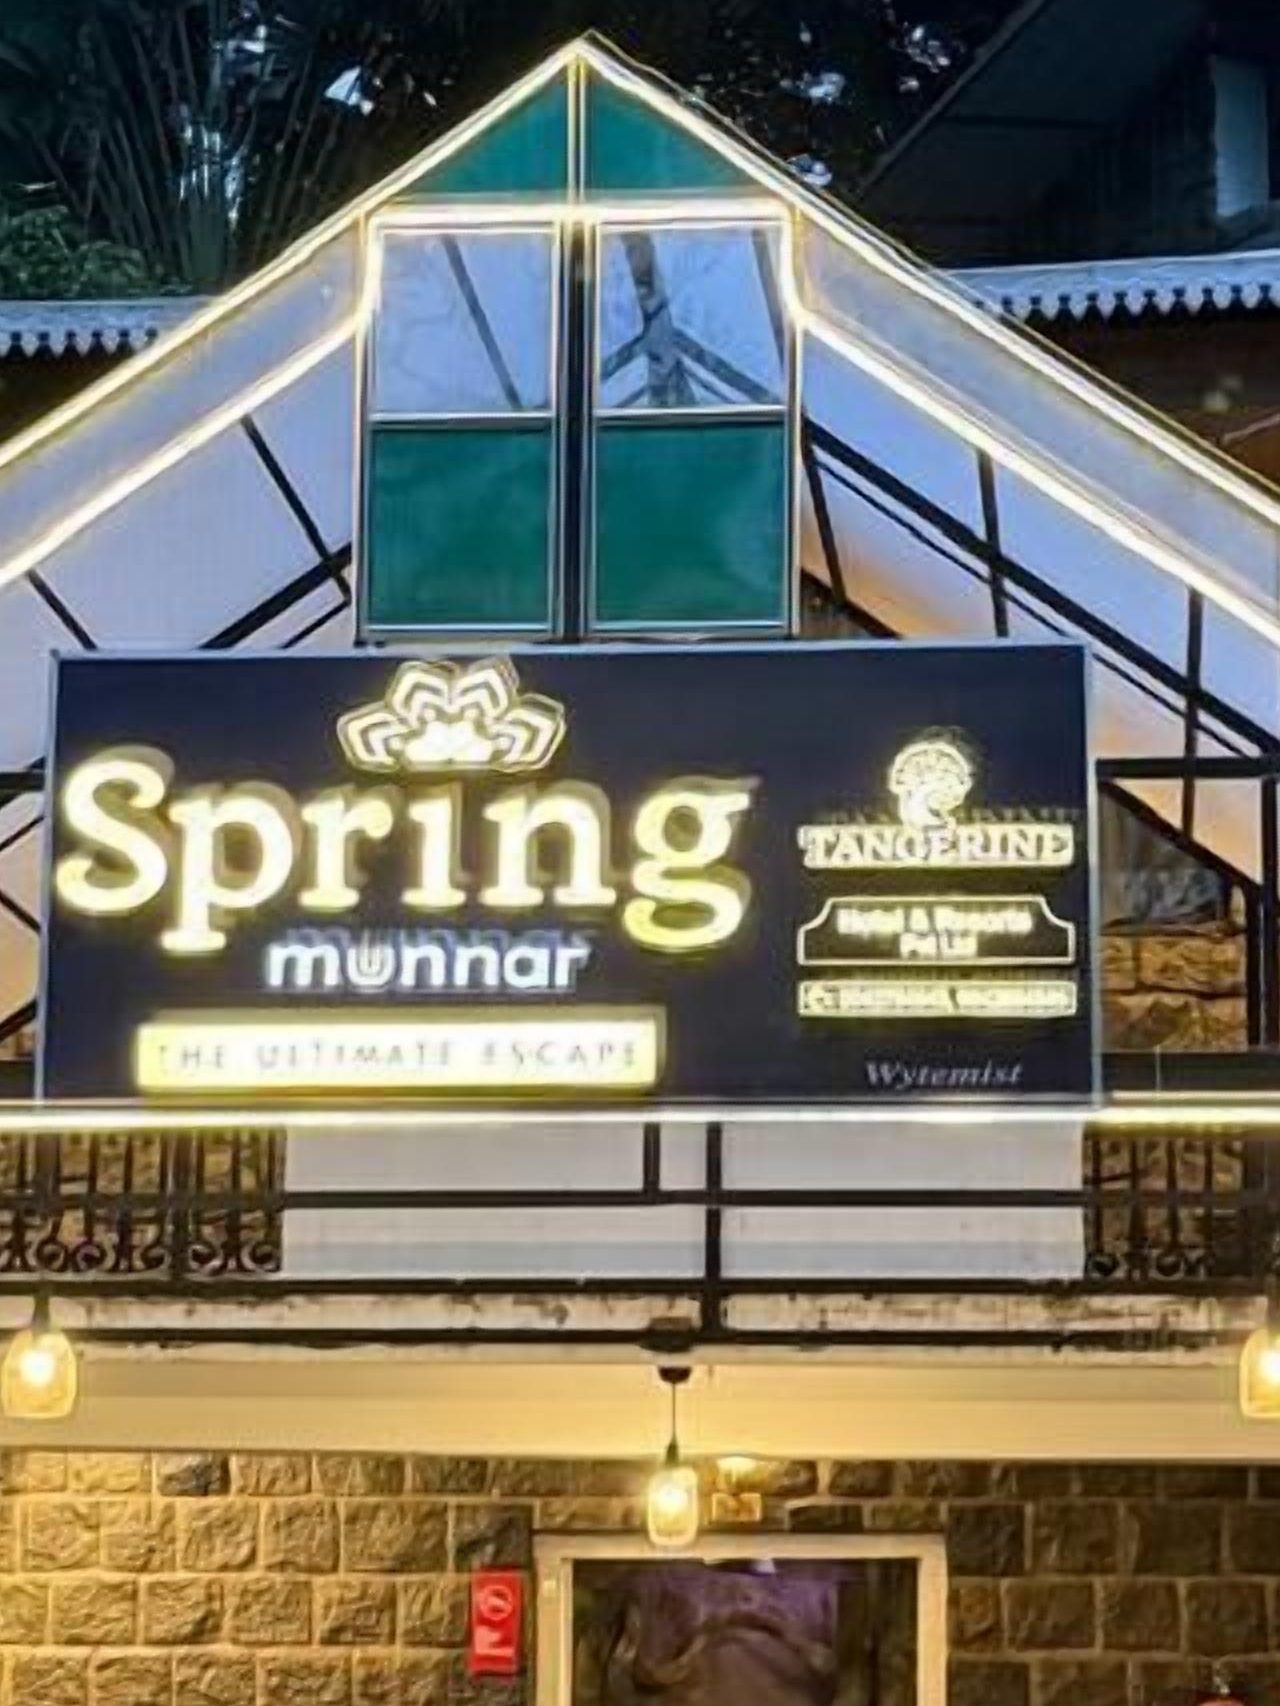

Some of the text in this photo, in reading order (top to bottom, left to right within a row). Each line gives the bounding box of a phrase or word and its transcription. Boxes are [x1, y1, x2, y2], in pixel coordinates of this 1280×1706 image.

[54, 757, 752, 954] Spring
[805, 825, 1073, 867] TANGERINE
[267, 943, 590, 988] munnar
[158, 1043, 225, 1070] THE
